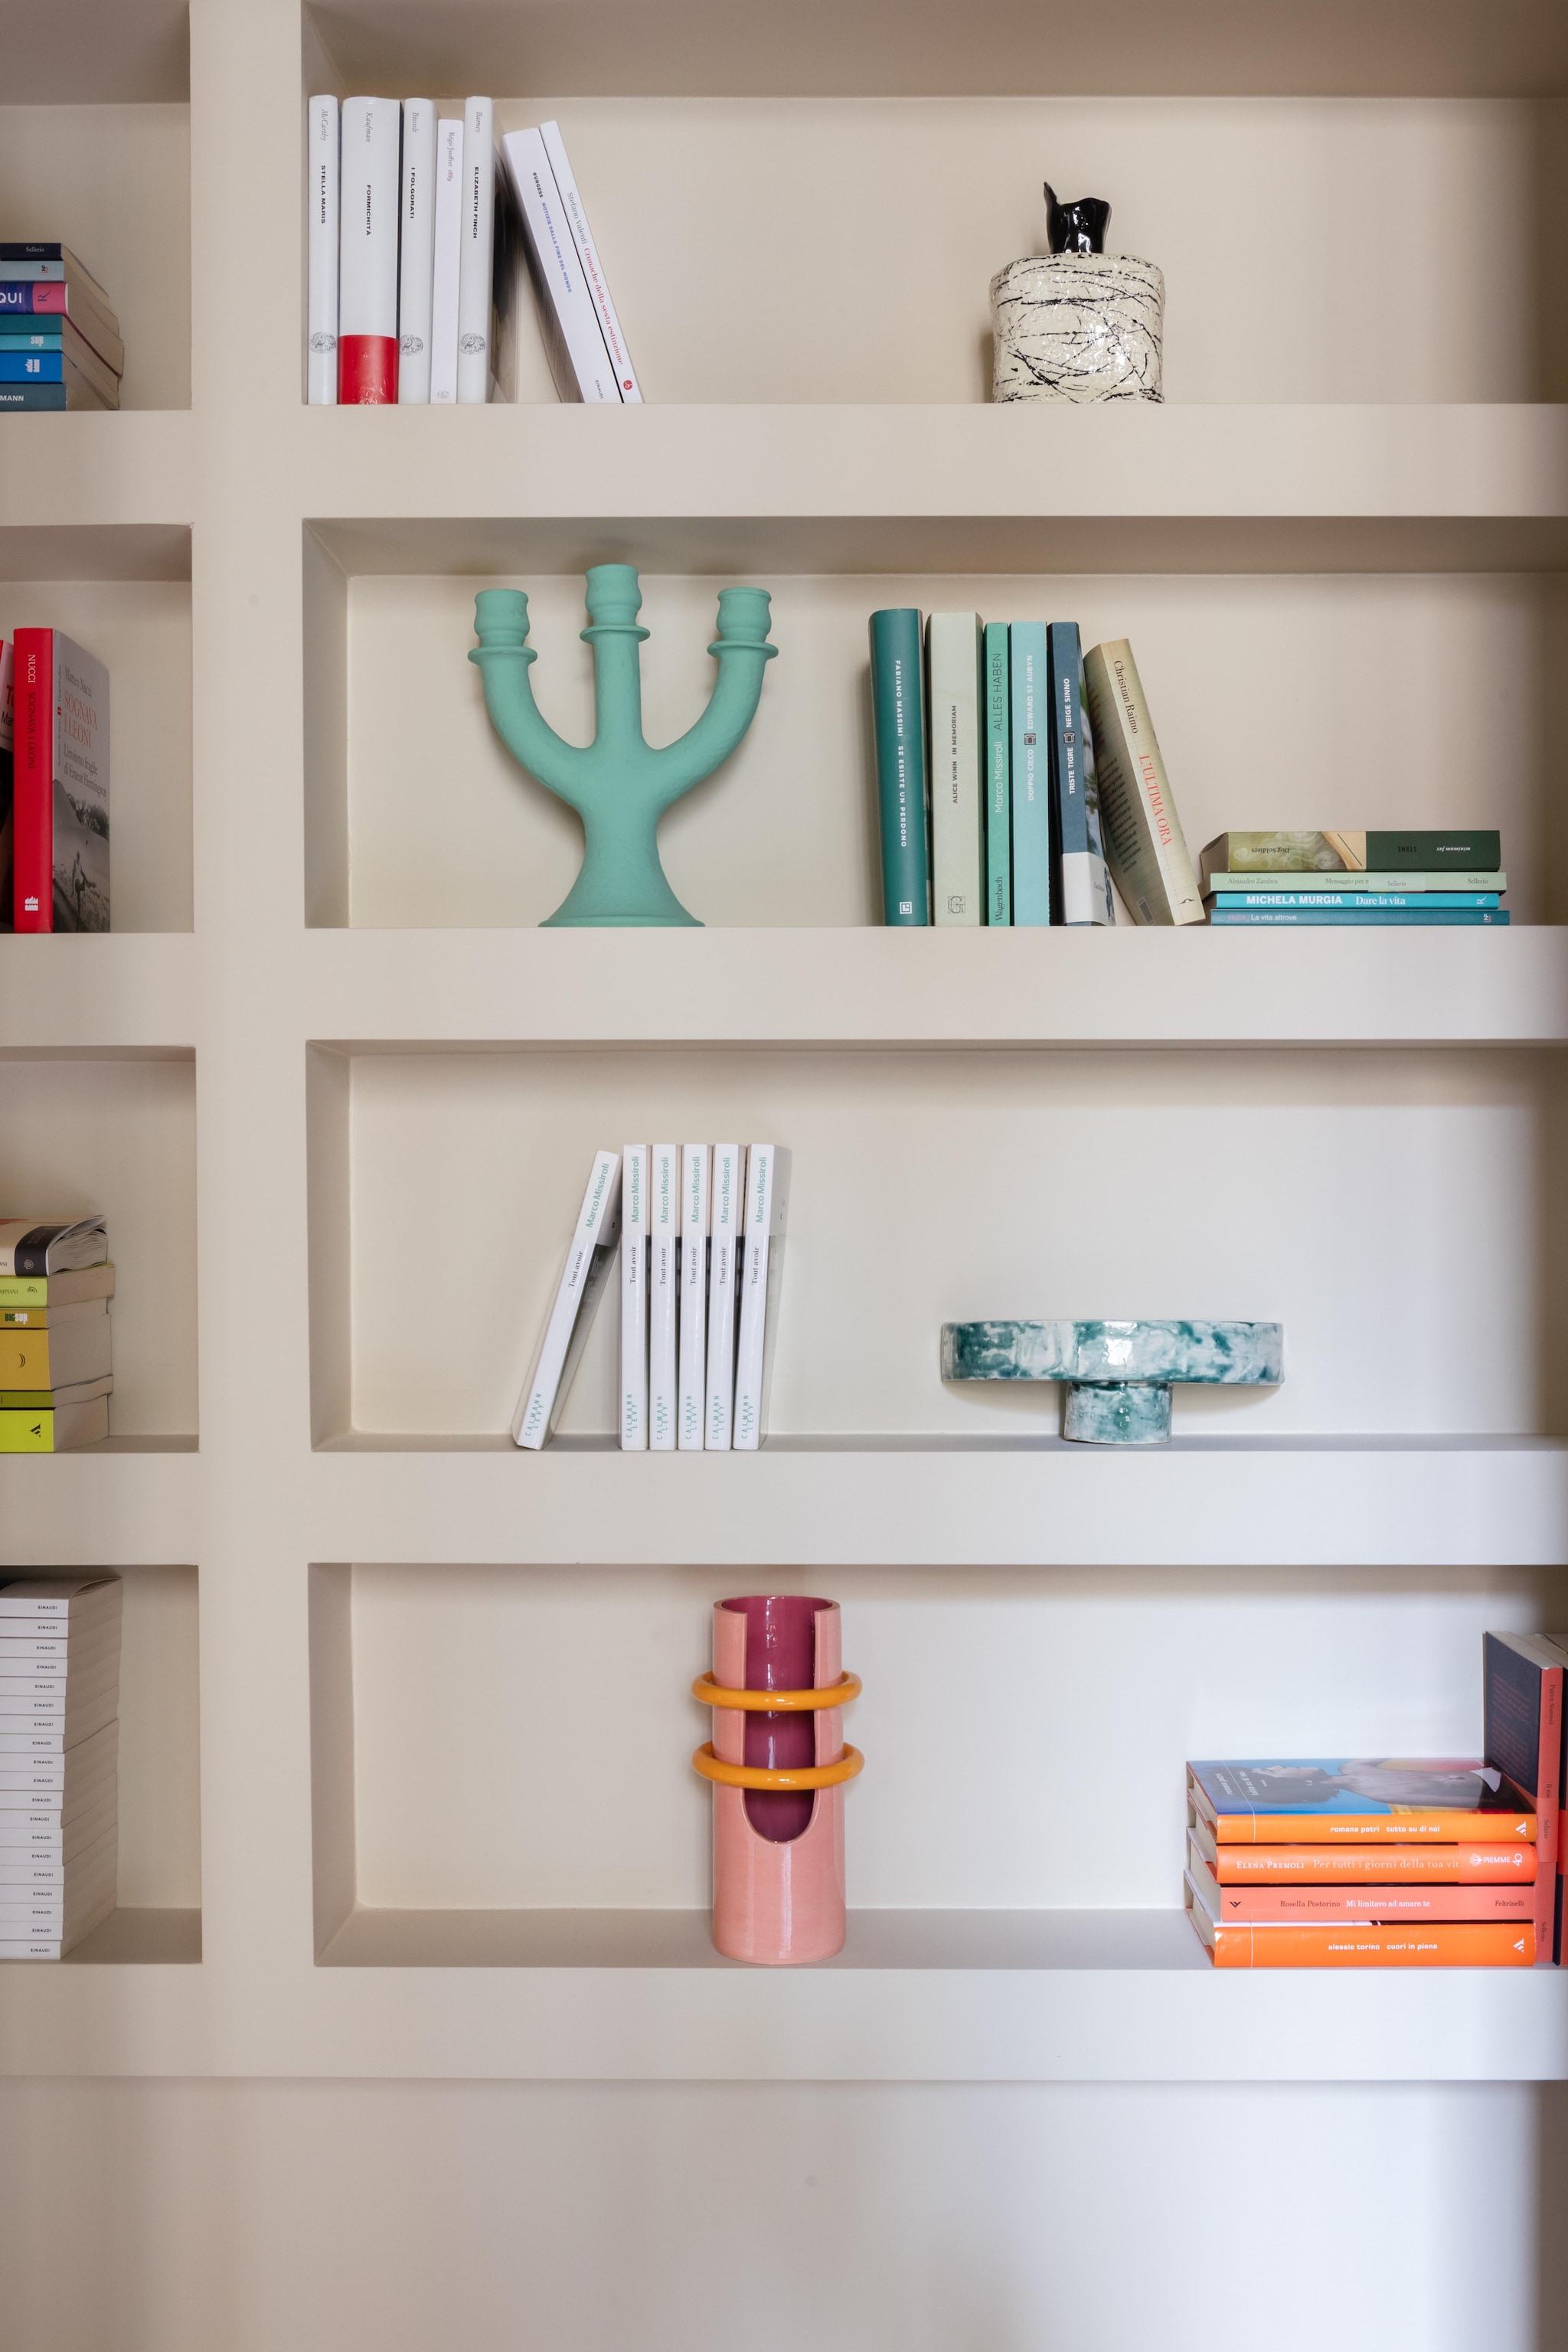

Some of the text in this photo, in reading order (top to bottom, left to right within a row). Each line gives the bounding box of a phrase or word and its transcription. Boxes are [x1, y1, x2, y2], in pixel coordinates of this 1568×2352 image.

[319, 109, 328, 142] McCarthy
[364, 112, 373, 142] Kaufman
[446, 132, 455, 147] Régis
[446, 146, 455, 167] Jauffret
[532, 172, 544, 198] BURGESS
[541, 202, 552, 225] NOTIZIE
[548, 226, 557, 245] DALLA
[562, 271, 572, 292] MONDO
[567, 191, 623, 365] Stefano Valenti Cronache della sesta estinzione
[595, 379, 604, 400] EINAUDI
[28, 654, 36, 683] NUCCI
[65, 665, 93, 698] Matteo Nucci
[1026, 684, 1033, 694] ST
[1063, 678, 1071, 703] SINNO
[27, 691, 36, 734] SOGNAVA
[64, 690, 98, 731] SOGNAVA
[69, 717, 92, 750] LEONI
[991, 653, 1004, 813] Marco Missiroli ALLES HABEN
[27, 741, 35, 769] LEONI
[897, 745, 904, 756] SE
[1113, 660, 1172, 846] Christian Raimo L'ULTIMA ORA
[899, 792, 906, 803] UN
[1067, 769, 1076, 795] TRISTE
[1276, 846, 1290, 854] Dog
[995, 877, 1004, 921] Wagenbach
[1246, 895, 1343, 904] MICHELA MURGIA
[1355, 896, 1406, 905] Dare la vita
[585, 1162, 609, 1228] Marco Missiroli
[631, 1156, 639, 1223] Marco Missiroli
[660, 1157, 669, 1223] Marco Missiroli
[691, 1156, 701, 1223] Marco Missiroli
[720, 1157, 730, 1223] Marco Missiroli
[755, 1156, 766, 1223] Marco Missiroli
[568, 1250, 583, 1287] Tout avoir
[1361, 1825, 1380, 1834] petri
[1313, 1860, 1331, 1869] Per
[1333, 1860, 1355, 1869] tutti
[1358, 1860, 1363, 1869] i
[1364, 1860, 1397, 1872] giorni
[1400, 1860, 1426, 1869] della
[1416, 1942, 1438, 1951] piena
